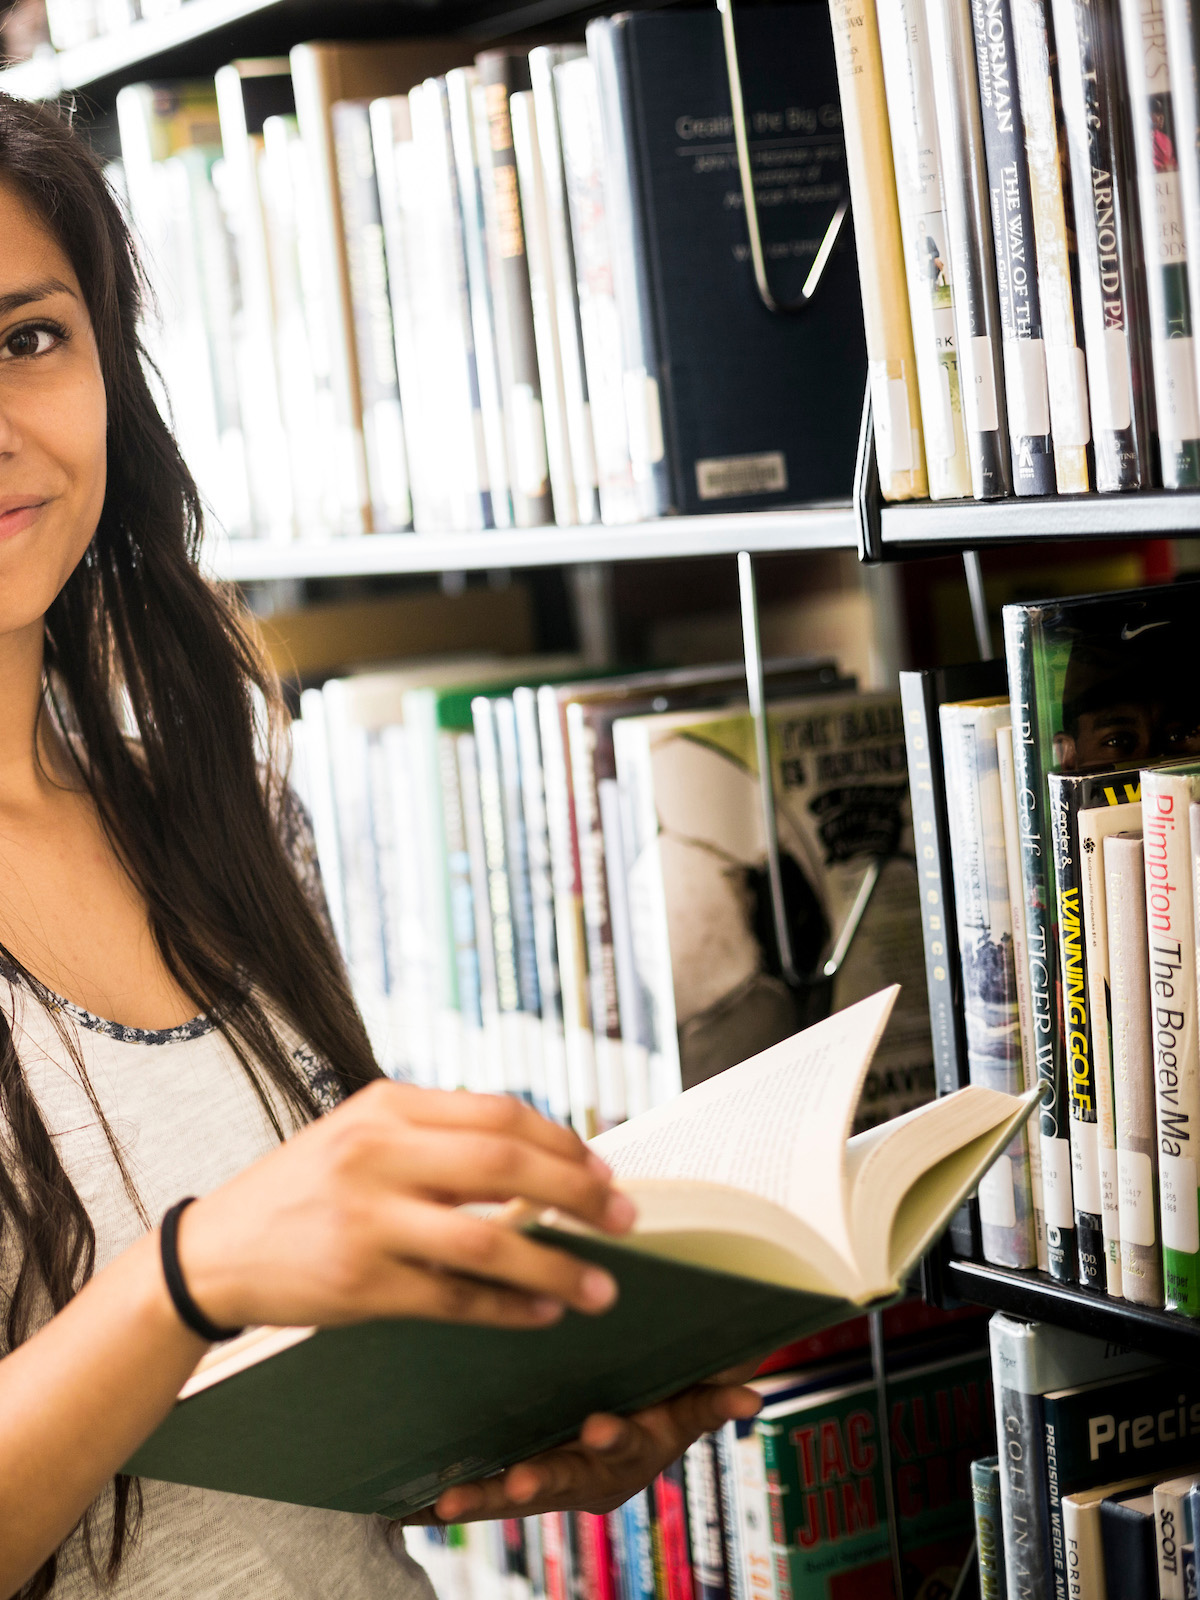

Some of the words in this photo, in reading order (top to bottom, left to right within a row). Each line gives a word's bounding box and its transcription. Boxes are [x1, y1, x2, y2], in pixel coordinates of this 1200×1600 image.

[979, 47, 992, 107] PHILLIPS
[1004, 161, 1020, 211] THE
[1007, 213, 1025, 262] WAY
[1091, 165, 1120, 293] ARNOLD
[1013, 266, 1029, 297] OF
[1015, 300, 1031, 341] TH
[1103, 298, 1124, 332] PA
[907, 709, 932, 791] golf
[921, 820, 946, 982] science
[1019, 788, 1041, 857] Golf
[1060, 801, 1071, 855] Zender
[1061, 857, 1073, 870] &
[1027, 925, 1051, 1034] TIGER
[1059, 886, 1087, 1025] WINNING
[1036, 1042, 1059, 1139] WOO
[1069, 1030, 1092, 1113] GOLF
[1161, 1107, 1190, 1158] Ma
[1005, 1415, 1026, 1500] GOLF
[1045, 1423, 1059, 1508] PRECISION
[793, 1476, 881, 1551] JIM
[1012, 1514, 1028, 1548] IN
[1051, 1512, 1064, 1570] WEDGE
[1160, 1508, 1178, 1576] SCOTT
[1068, 1537, 1080, 1600] FORB
